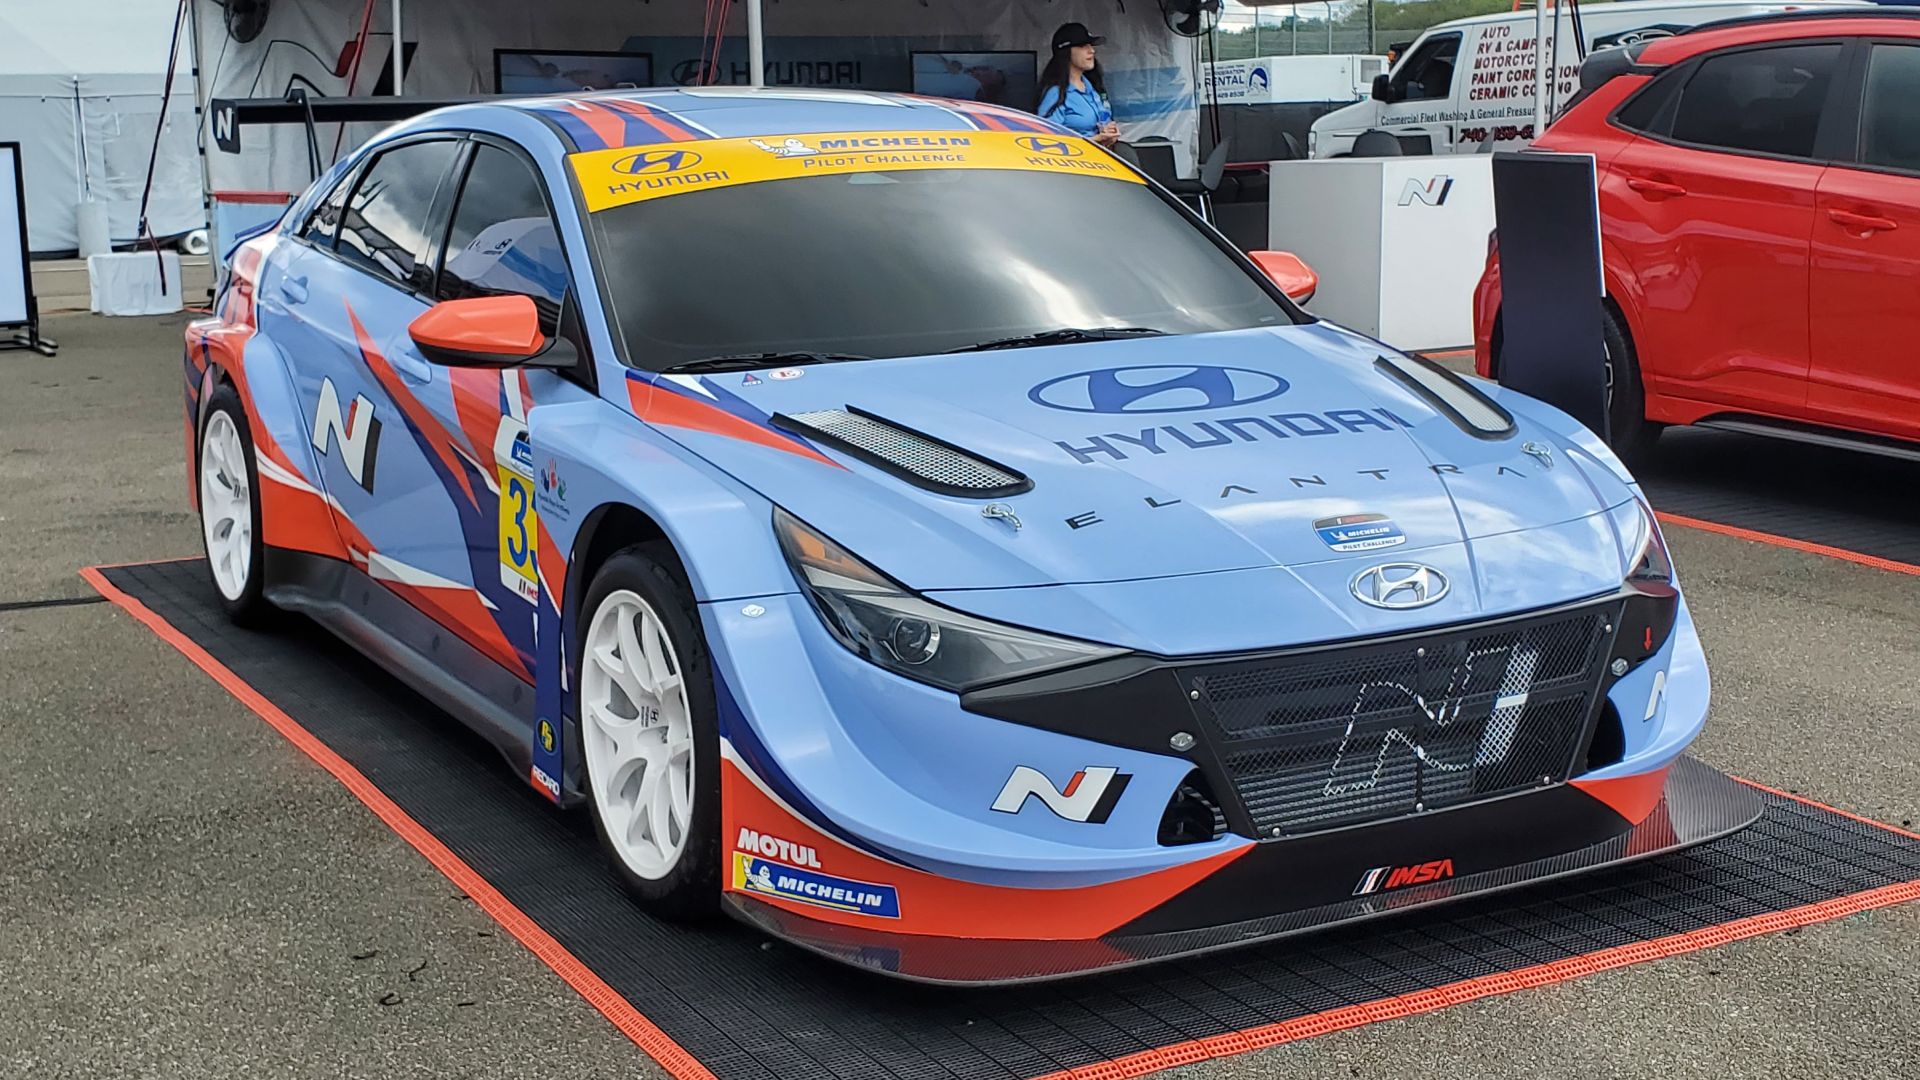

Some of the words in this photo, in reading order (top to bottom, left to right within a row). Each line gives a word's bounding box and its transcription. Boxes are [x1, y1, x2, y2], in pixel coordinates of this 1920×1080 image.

[1480, 26, 1510, 39] AUTO
[1477, 42, 1491, 54] RV
[1495, 42, 1502, 53] &
[1506, 37, 1552, 51] CAMPR
[1474, 52, 1550, 69] MOTORCYC
[1471, 71, 1503, 85] PAINT
[1506, 65, 1580, 82] CORRCION
[1469, 85, 1518, 101] CERAMIC
[1522, 82, 1572, 98] COTNG
[1381, 113, 1419, 126] Commercial
[1420, 112, 1437, 123] Fleet
[1439, 110, 1468, 122] Washing
[1470, 109, 1475, 119] &
[1477, 107, 1505, 119] General
[1507, 106, 1536, 116] Pressur
[820, 137, 971, 149] MICHELIN
[803, 157, 857, 168] PILOT
[864, 153, 966, 164] CHALLENGE
[1026, 156, 1116, 173] HYUNDAI
[608, 170, 730, 195] HYUNDAI
[1055, 407, 1415, 465] HYUNDAI
[1064, 463, 1527, 531] ELANTRA
[1347, 527, 1390, 537] MICHELIN
[1362, 539, 1397, 548] CHALLENGE
[532, 764, 560, 796] RECARO
[737, 827, 822, 869] MOTUL
[1384, 858, 1454, 889] IMSA
[777, 875, 882, 907] MICHELIN
